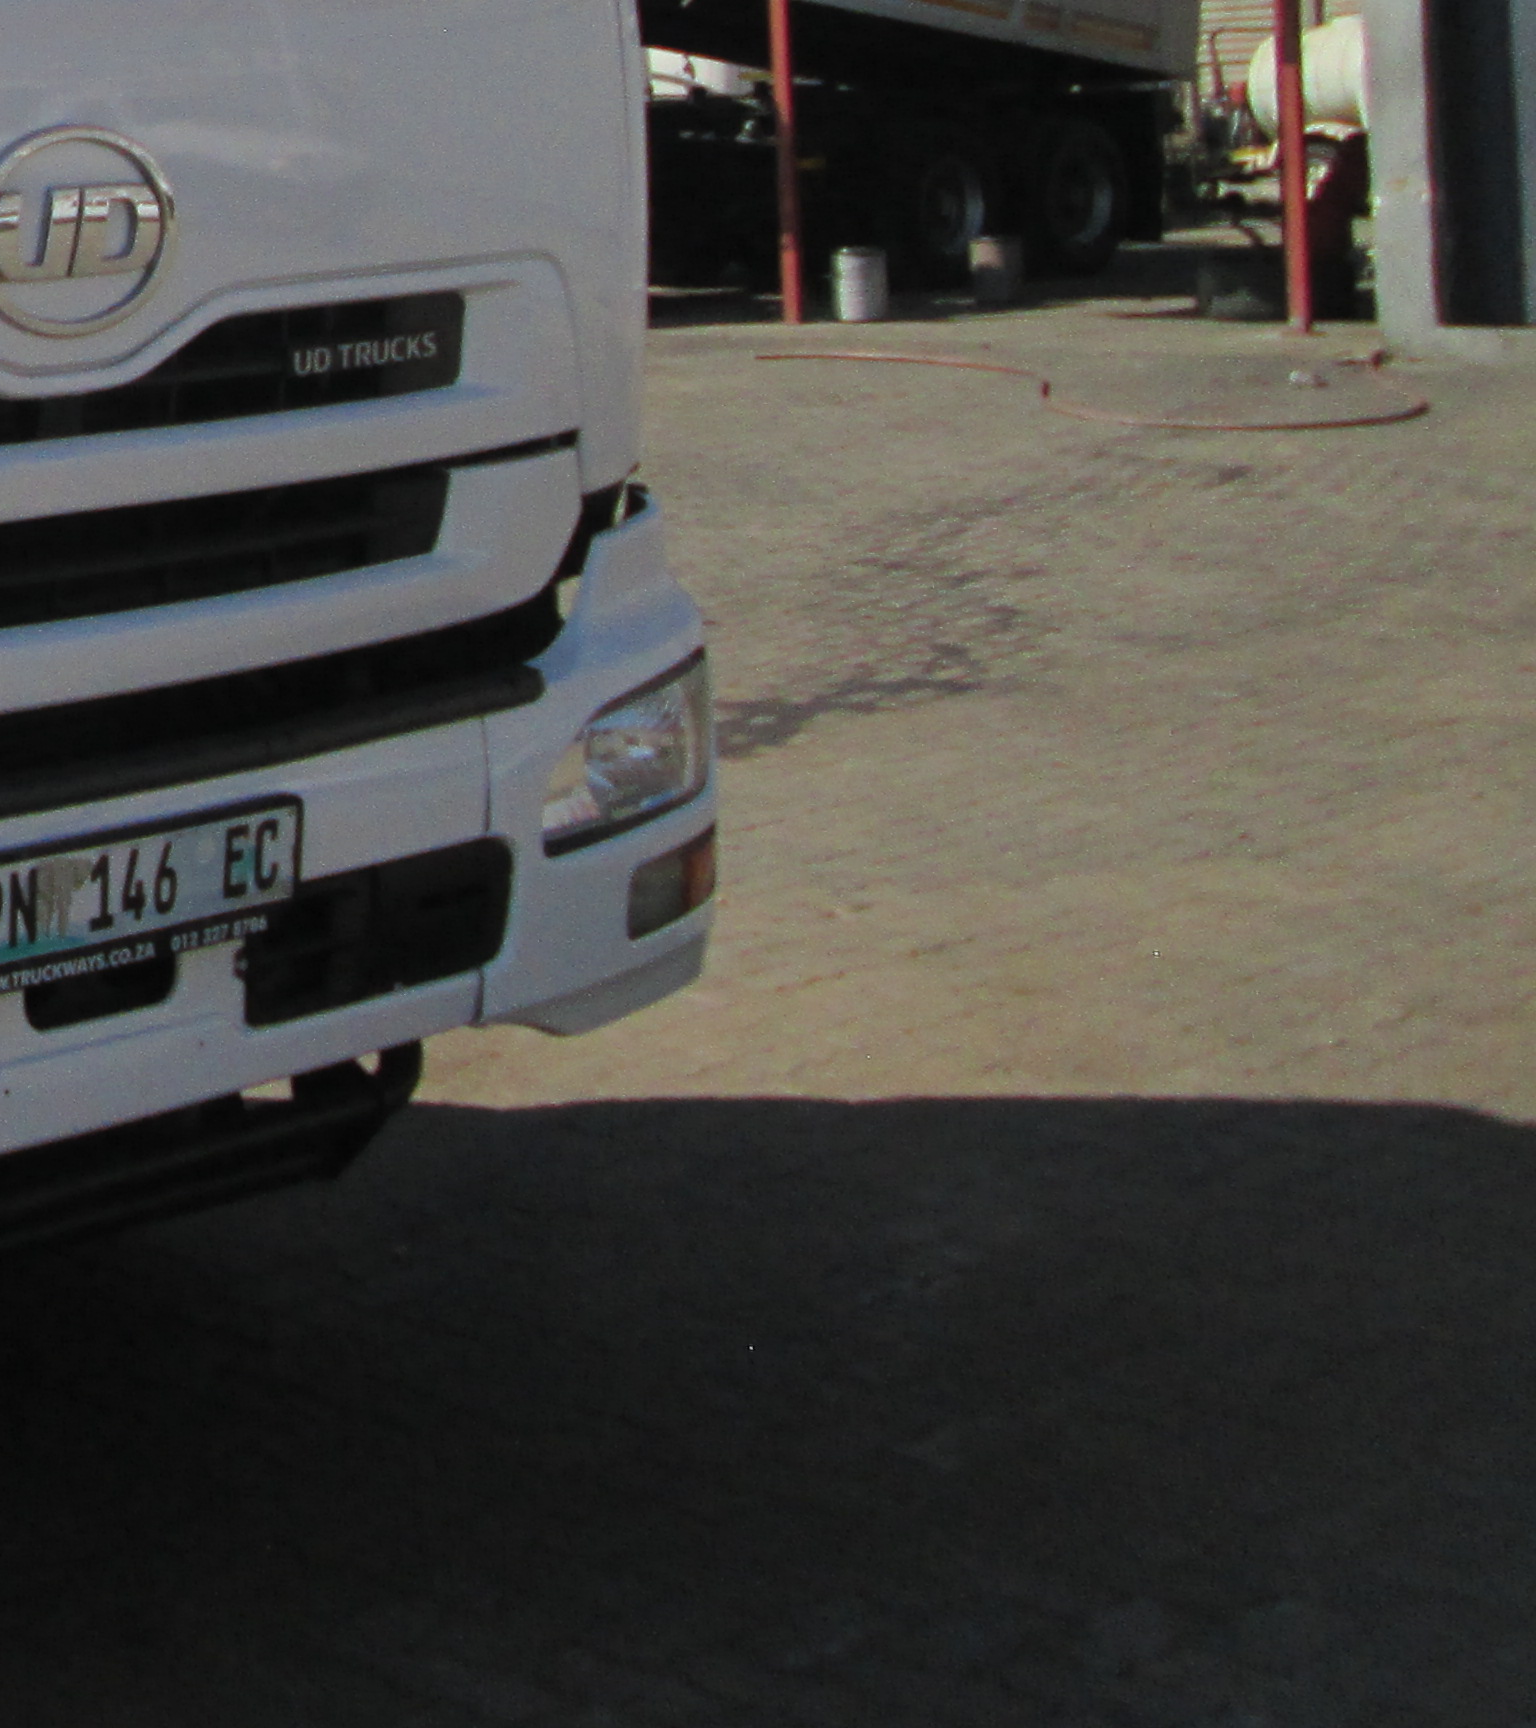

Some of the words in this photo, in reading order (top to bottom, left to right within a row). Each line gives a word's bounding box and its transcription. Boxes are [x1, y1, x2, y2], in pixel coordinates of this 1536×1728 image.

[293, 347, 331, 375] UD
[338, 332, 437, 369] TRUCKS
[89, 842, 178, 932] 146
[223, 820, 279, 899] EC
